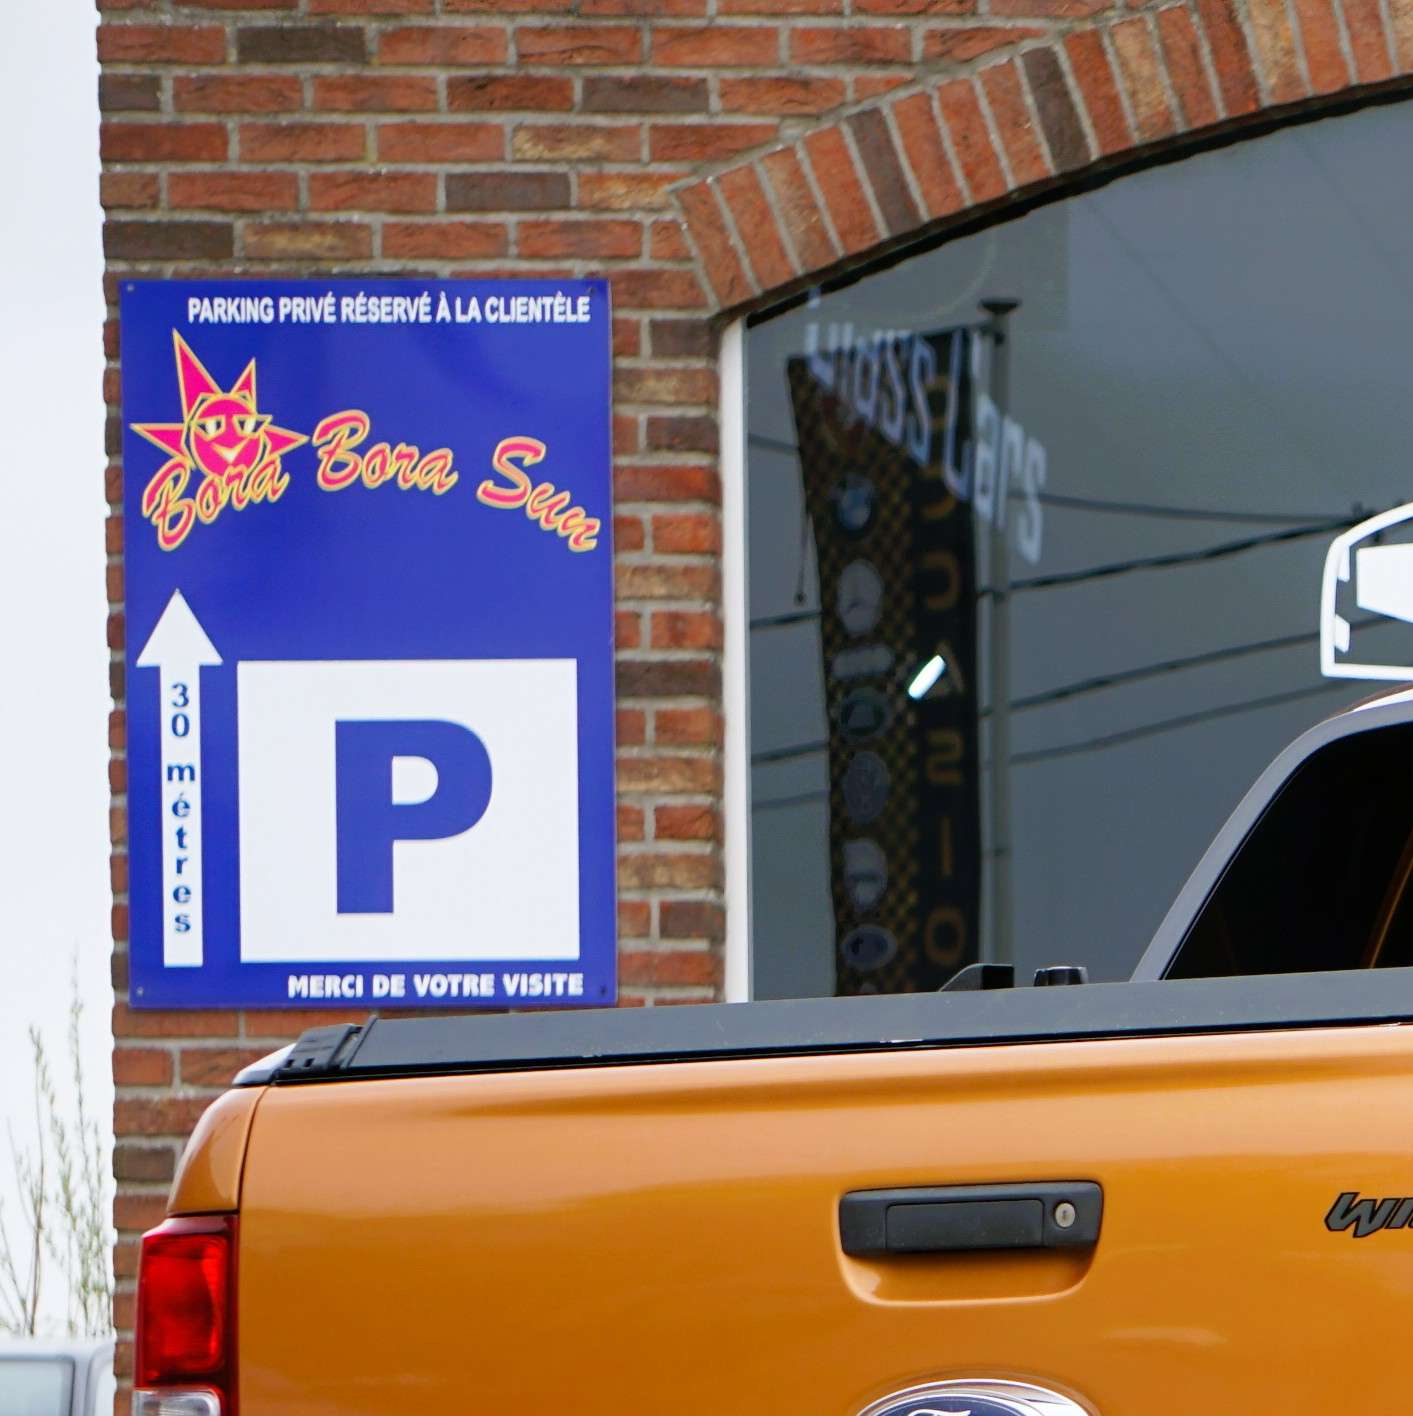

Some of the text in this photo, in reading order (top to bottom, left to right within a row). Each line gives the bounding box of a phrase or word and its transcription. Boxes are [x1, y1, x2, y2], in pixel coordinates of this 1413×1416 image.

[187, 290, 592, 323] PARKING PRIVÉ RÉSERVÉ À LA CLIENTÈLE
[142, 409, 601, 553] Bora Bora Sun
[170, 683, 190, 738] 30
[335, 718, 494, 915] P
[287, 972, 584, 998] MERCI DE VOTRE VISITE
